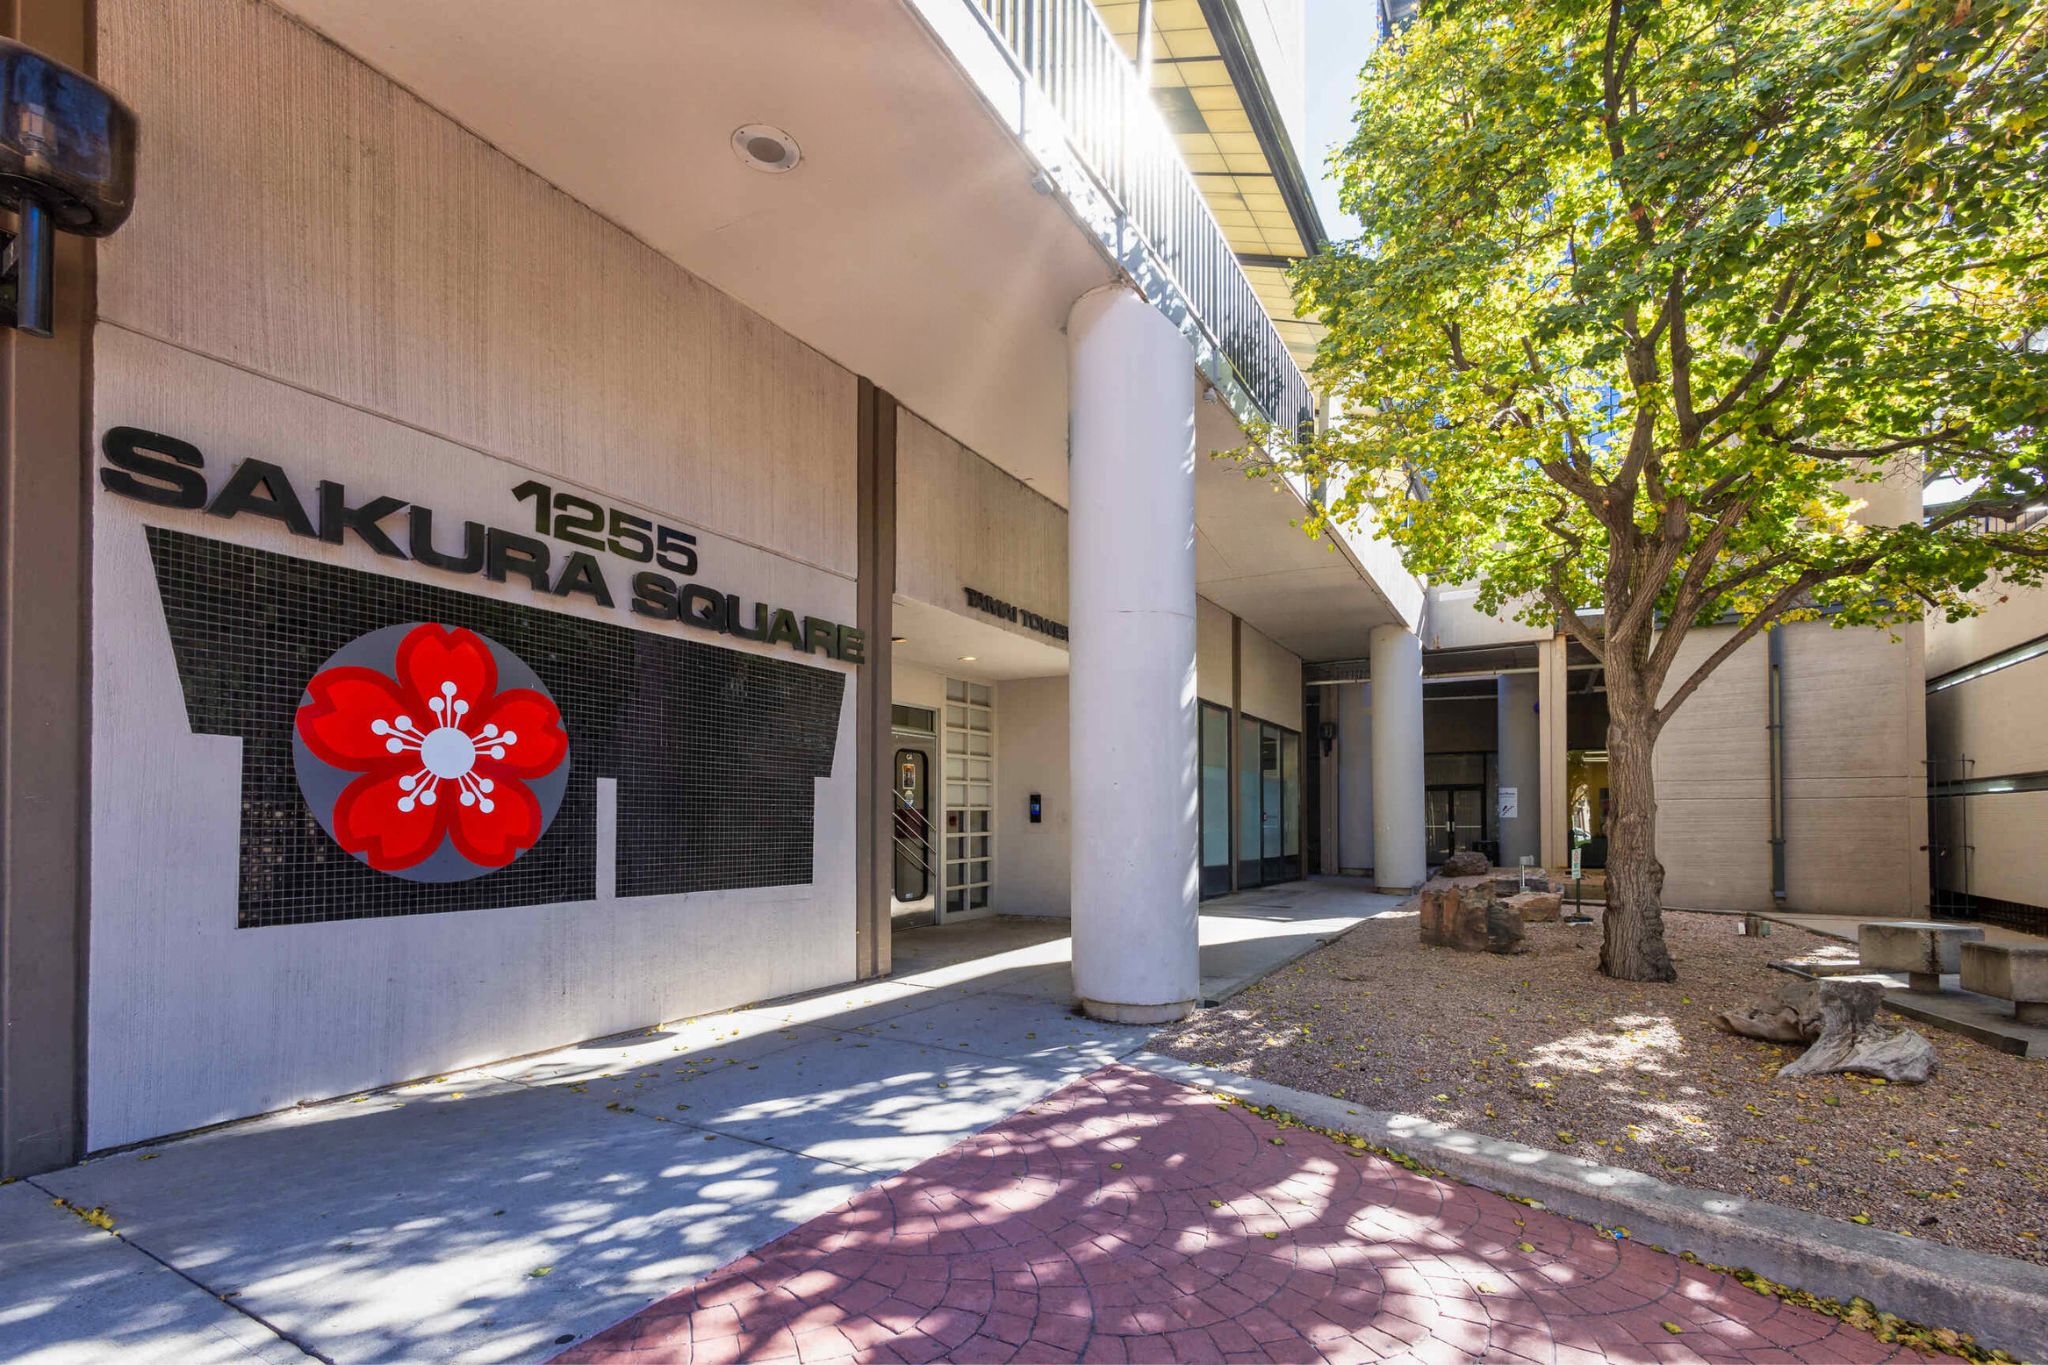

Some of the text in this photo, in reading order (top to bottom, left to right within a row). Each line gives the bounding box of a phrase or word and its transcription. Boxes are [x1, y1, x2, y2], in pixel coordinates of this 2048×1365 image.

[100, 426, 865, 663] SAKURA SQUARE
[511, 480, 698, 576] 1255
